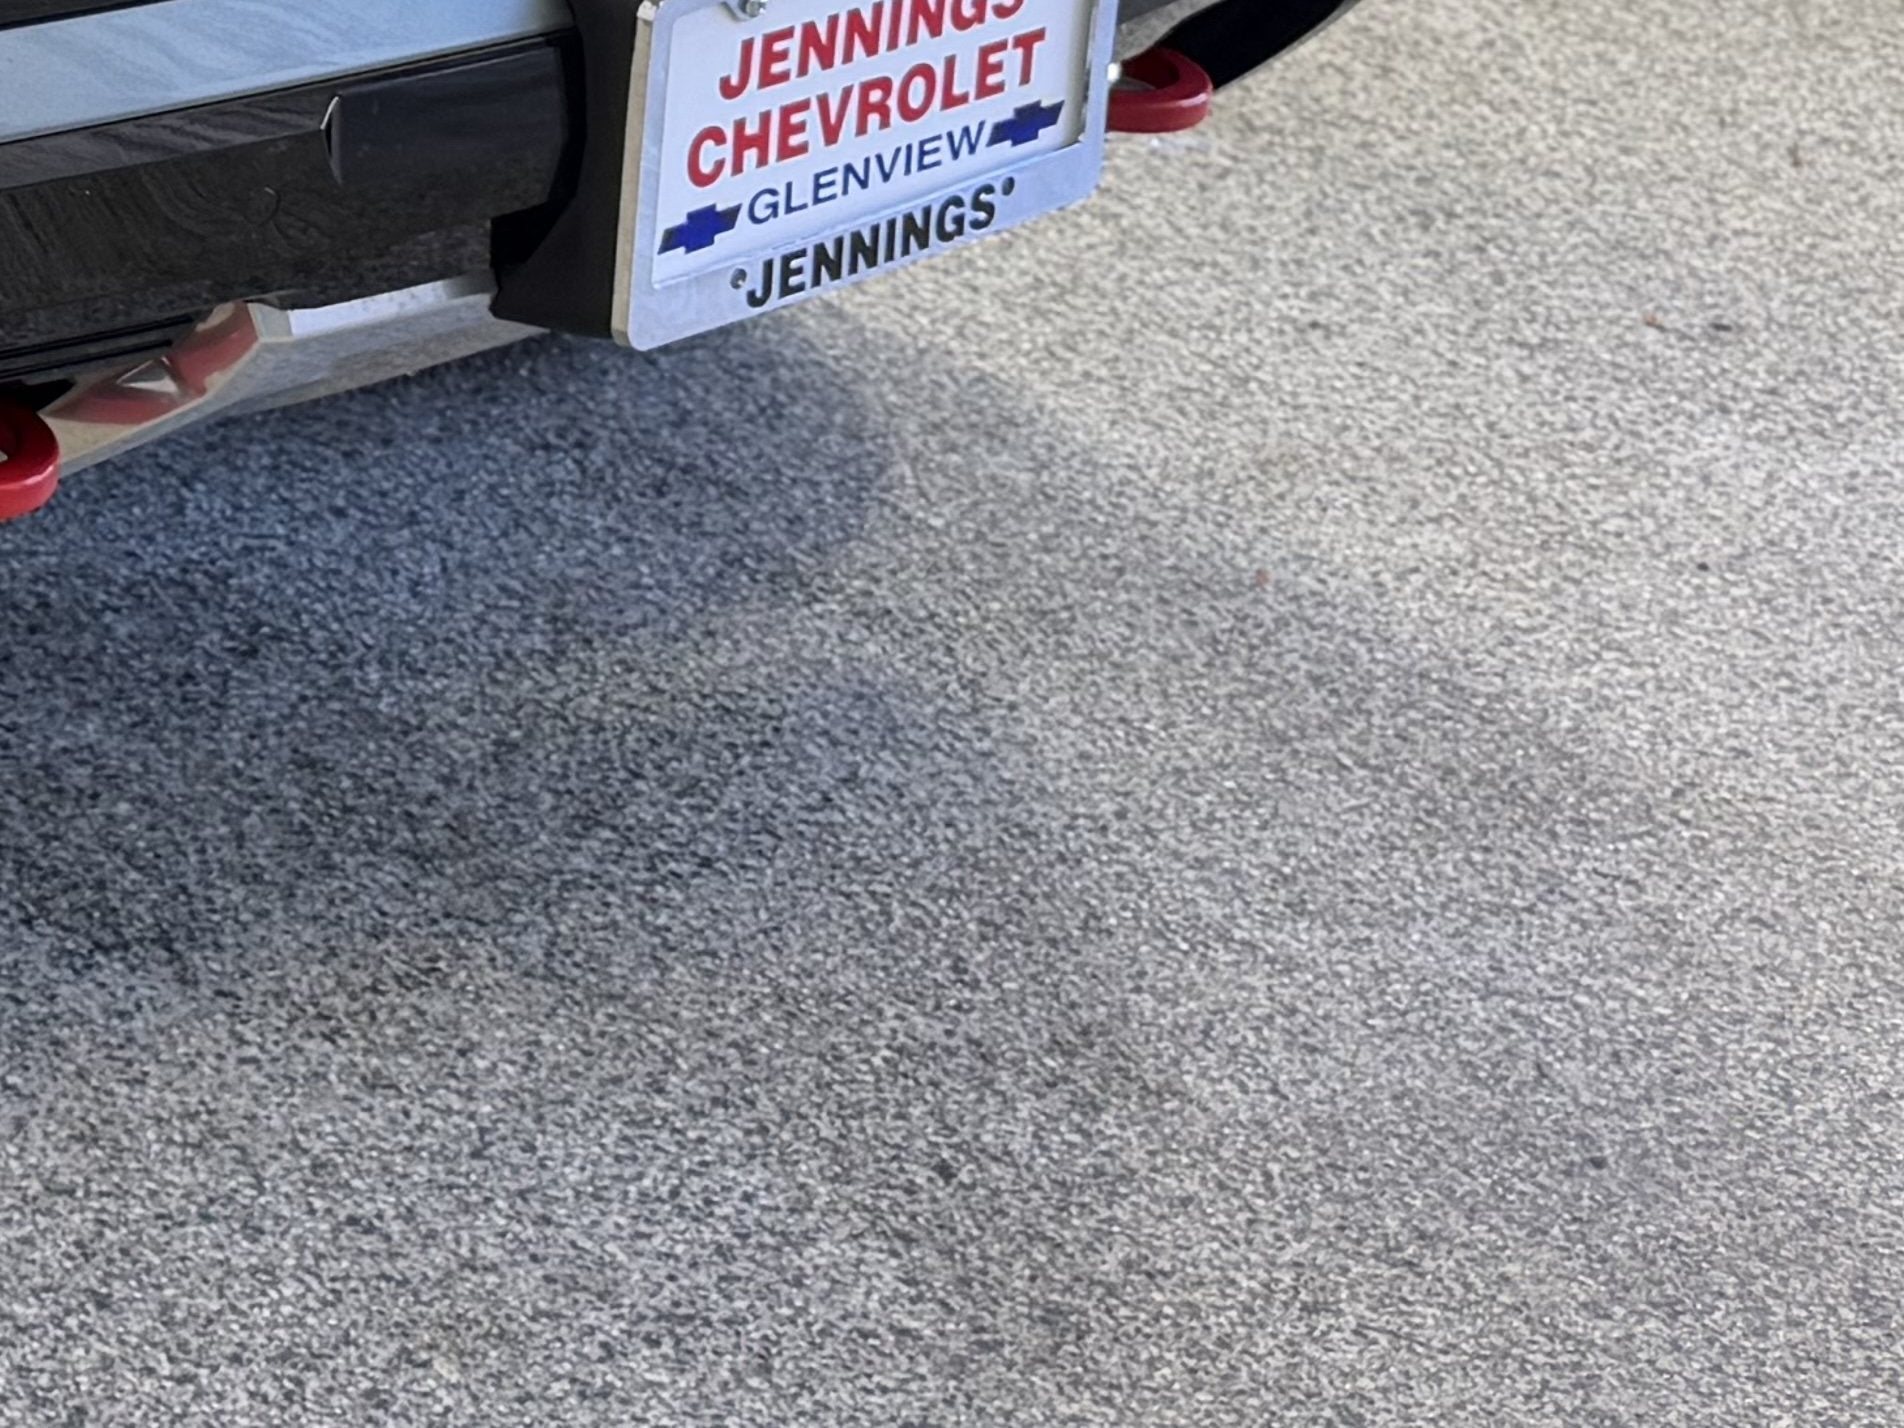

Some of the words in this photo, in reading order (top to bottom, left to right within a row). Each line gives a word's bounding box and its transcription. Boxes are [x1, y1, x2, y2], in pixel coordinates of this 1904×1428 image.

[686, 27, 1047, 188] CHEVROLET
[746, 120, 986, 226] GLENVIEW
[745, 184, 997, 309] JENNINGS
